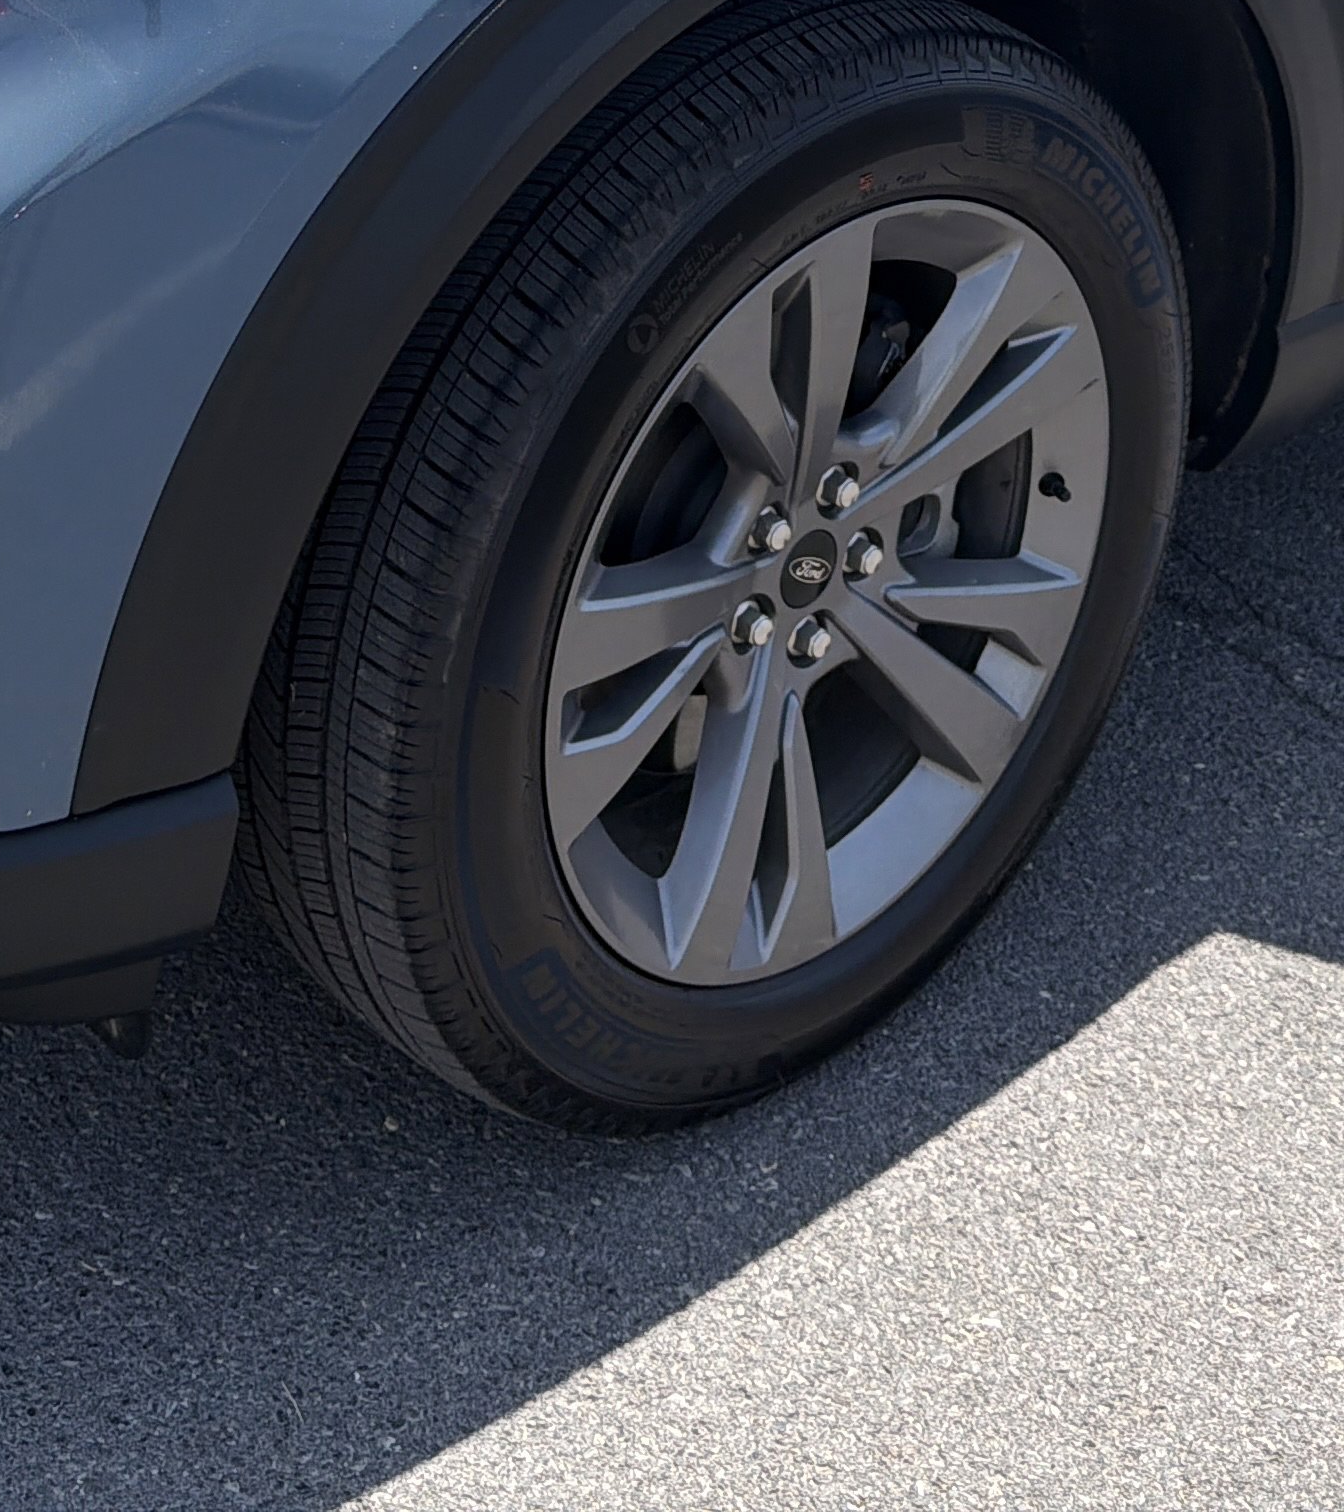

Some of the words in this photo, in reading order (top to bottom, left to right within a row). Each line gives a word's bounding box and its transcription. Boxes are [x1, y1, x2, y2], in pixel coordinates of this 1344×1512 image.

[1040, 137, 1164, 297] MICHELIN
[652, 243, 715, 314] MICHELIN
[794, 559, 827, 580] Ford
